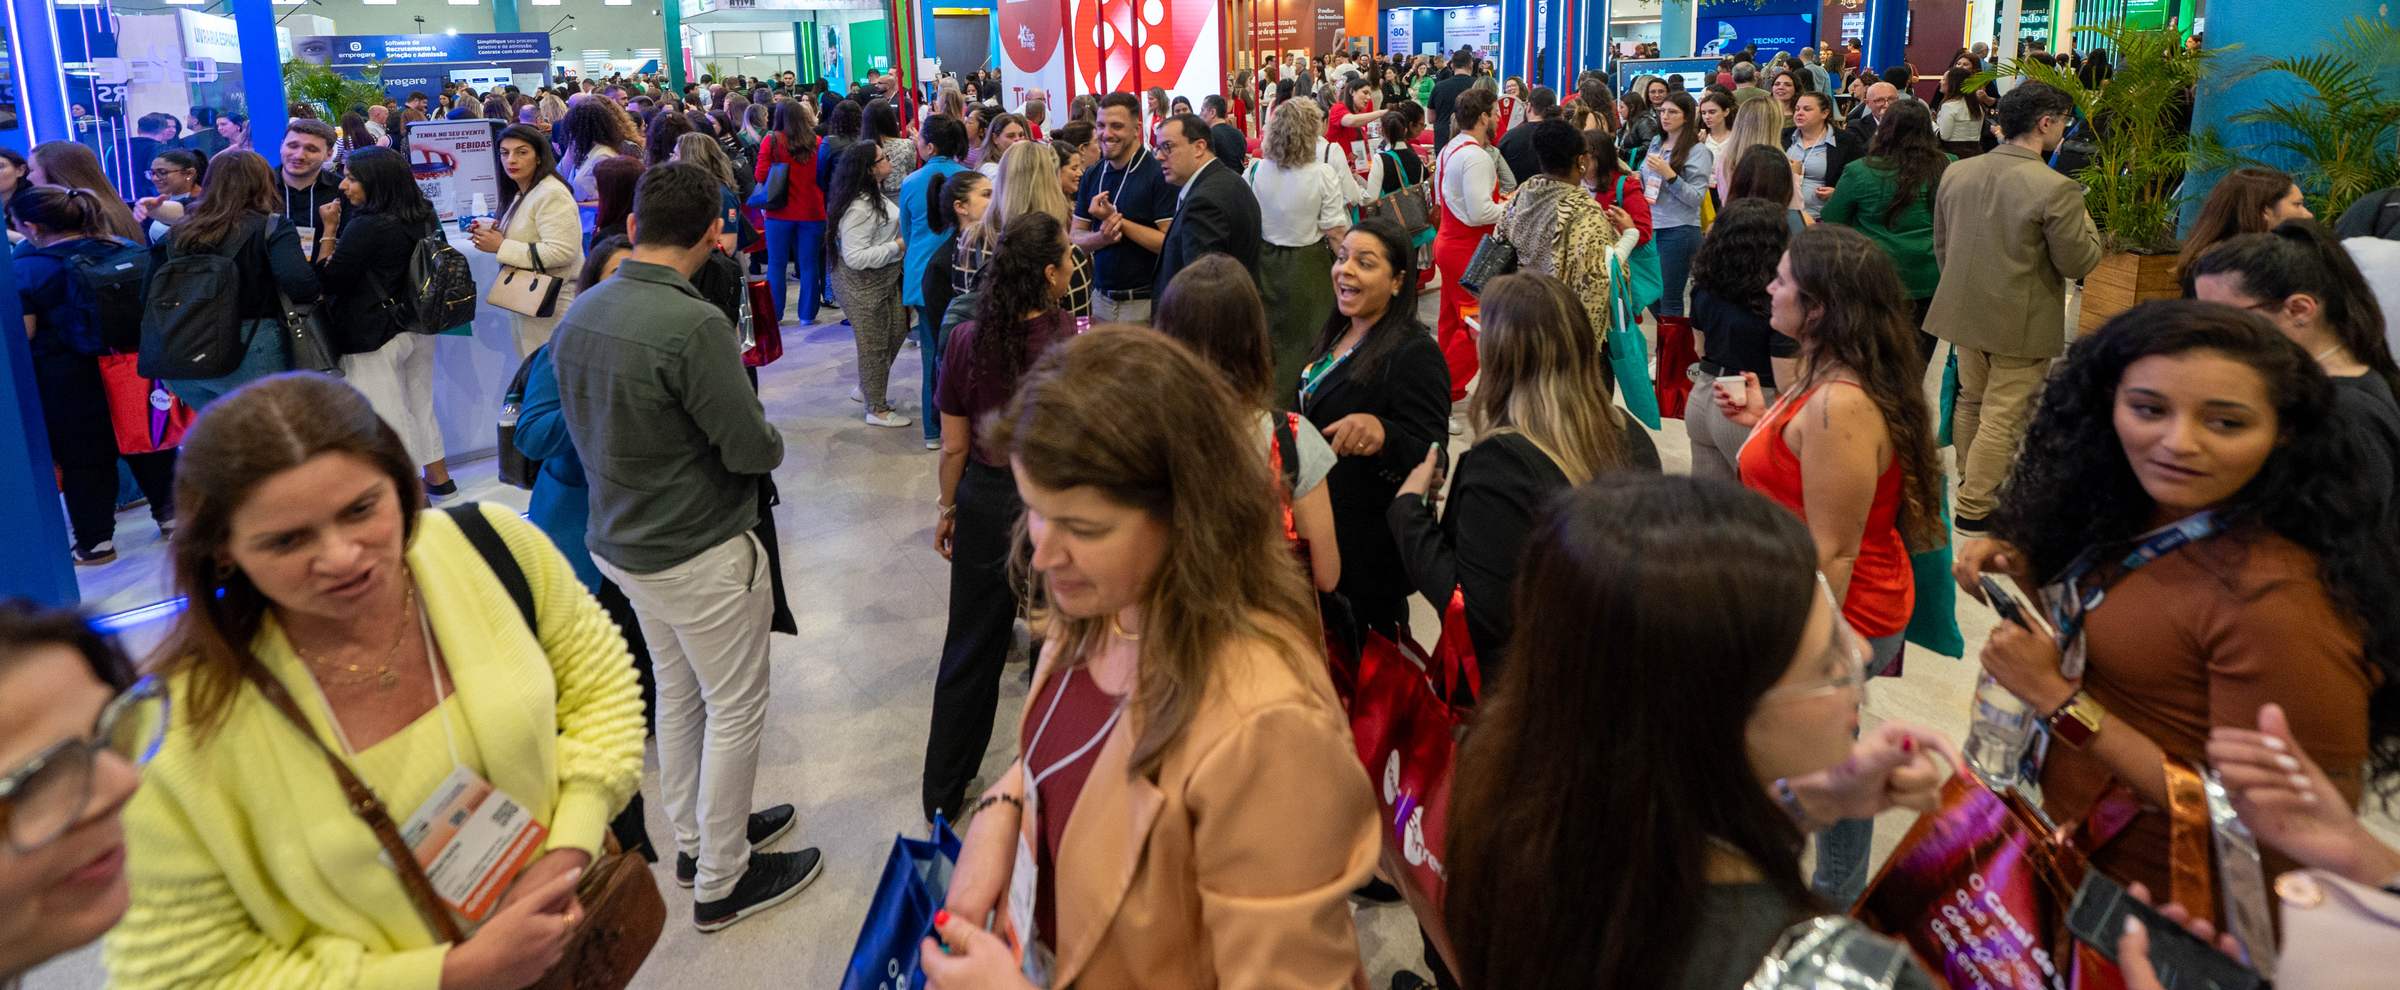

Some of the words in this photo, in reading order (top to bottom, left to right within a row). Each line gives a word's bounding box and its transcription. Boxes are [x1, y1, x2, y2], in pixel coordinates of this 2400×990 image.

[455, 140, 492, 150] BEBIDAS
[1956, 888, 1987, 926] que
[1968, 872, 1985, 892] O
[1984, 891, 2035, 948] Canal
[2031, 947, 2055, 977] de
[1930, 918, 1959, 954] das
